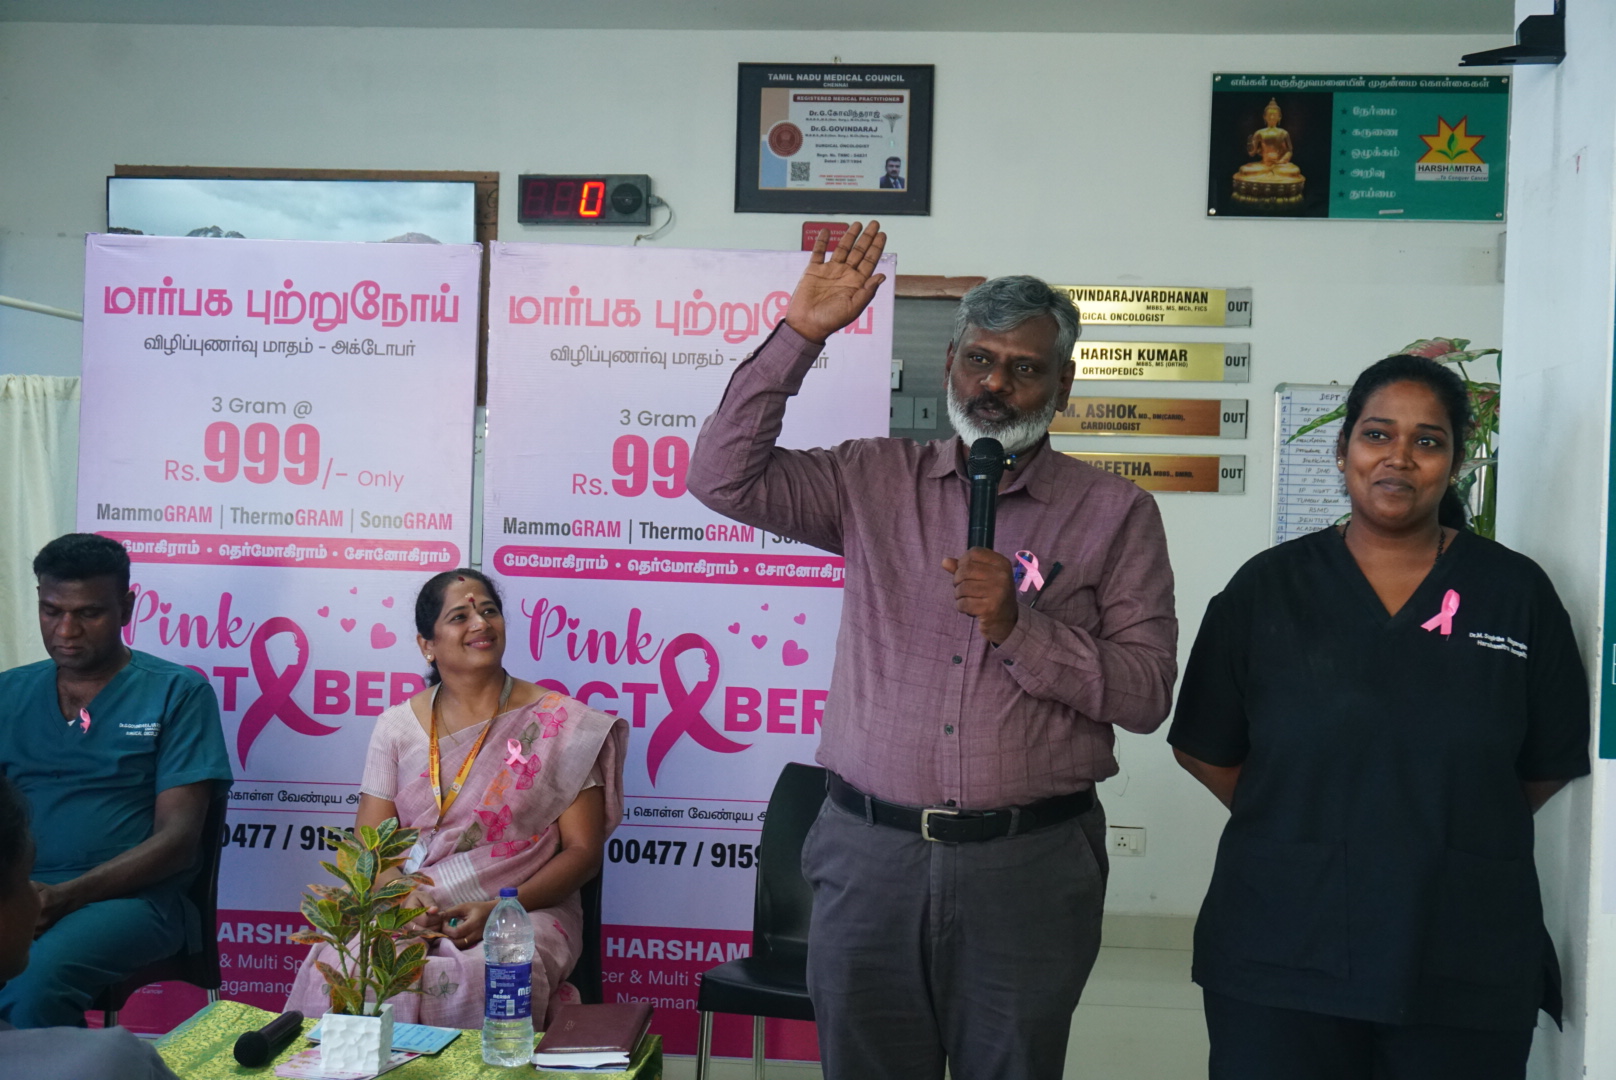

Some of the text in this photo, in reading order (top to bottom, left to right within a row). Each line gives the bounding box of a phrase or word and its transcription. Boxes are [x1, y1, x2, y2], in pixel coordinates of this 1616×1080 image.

[768, 73, 905, 82] TAMIL NADU MEDICAL COUNCIL
[1230, 76, 1268, 88] எங்கள்
[1368, 77, 1418, 88] முதன்மை
[1419, 77, 1490, 89] கொள்கைகள்
[1351, 126, 1399, 138] கருணை
[1418, 164, 1482, 173] HARSHAMITRA
[579, 181, 605, 217] 0
[104, 275, 460, 333] மார்பக புற்றுநோய்
[508, 285, 642, 328] மார்பக
[1227, 301, 1249, 312] OUT
[1079, 312, 1165, 322] GICAL ONCOLOGIST
[143, 333, 258, 358] விழிப்புணர்வு
[262, 336, 314, 358] மாதம்
[331, 338, 416, 357] அக்டோபர்
[1080, 348, 1188, 362] HARISH KUMAR
[549, 344, 667, 369] விழிப்புணர்வு
[671, 347, 724, 369] மாதம்
[1225, 355, 1248, 367] OUT
[1082, 367, 1144, 376] ORTHOPEDICS
[211, 396, 313, 419] 3 Gram @
[1086, 404, 1138, 419] ASHOK
[619, 408, 697, 428] 3 Gram
[1081, 421, 1142, 431] CARDIOLOGIST
[1223, 412, 1245, 423] OUT
[357, 470, 405, 493] Only
[1221, 468, 1243, 479] OUT
[96, 502, 453, 531] MammoGRAM ThermoGRAM SonoGRAM
[503, 516, 622, 539] MammoGRAM
[638, 521, 755, 544] ThermoGRAM
[217, 543, 328, 562] தெர்மோகிராம்
[344, 546, 451, 565] சோனோகிராம்
[503, 553, 609, 573] மேமோகிராம்
[627, 556, 739, 577] தெர்மோகிராம்
[122, 582, 256, 649] Pink
[521, 597, 665, 666] Pink
[277, 790, 342, 805] வேண்டிய
[634, 805, 684, 819] கொள்ள
[688, 807, 754, 824] வேண்டிய
[608, 838, 688, 866] 00477
[606, 937, 750, 963] HARSHAM
[220, 953, 232, 968] &
[238, 954, 278, 970] Multi
[629, 970, 642, 984] &
[648, 971, 689, 986] Multi
